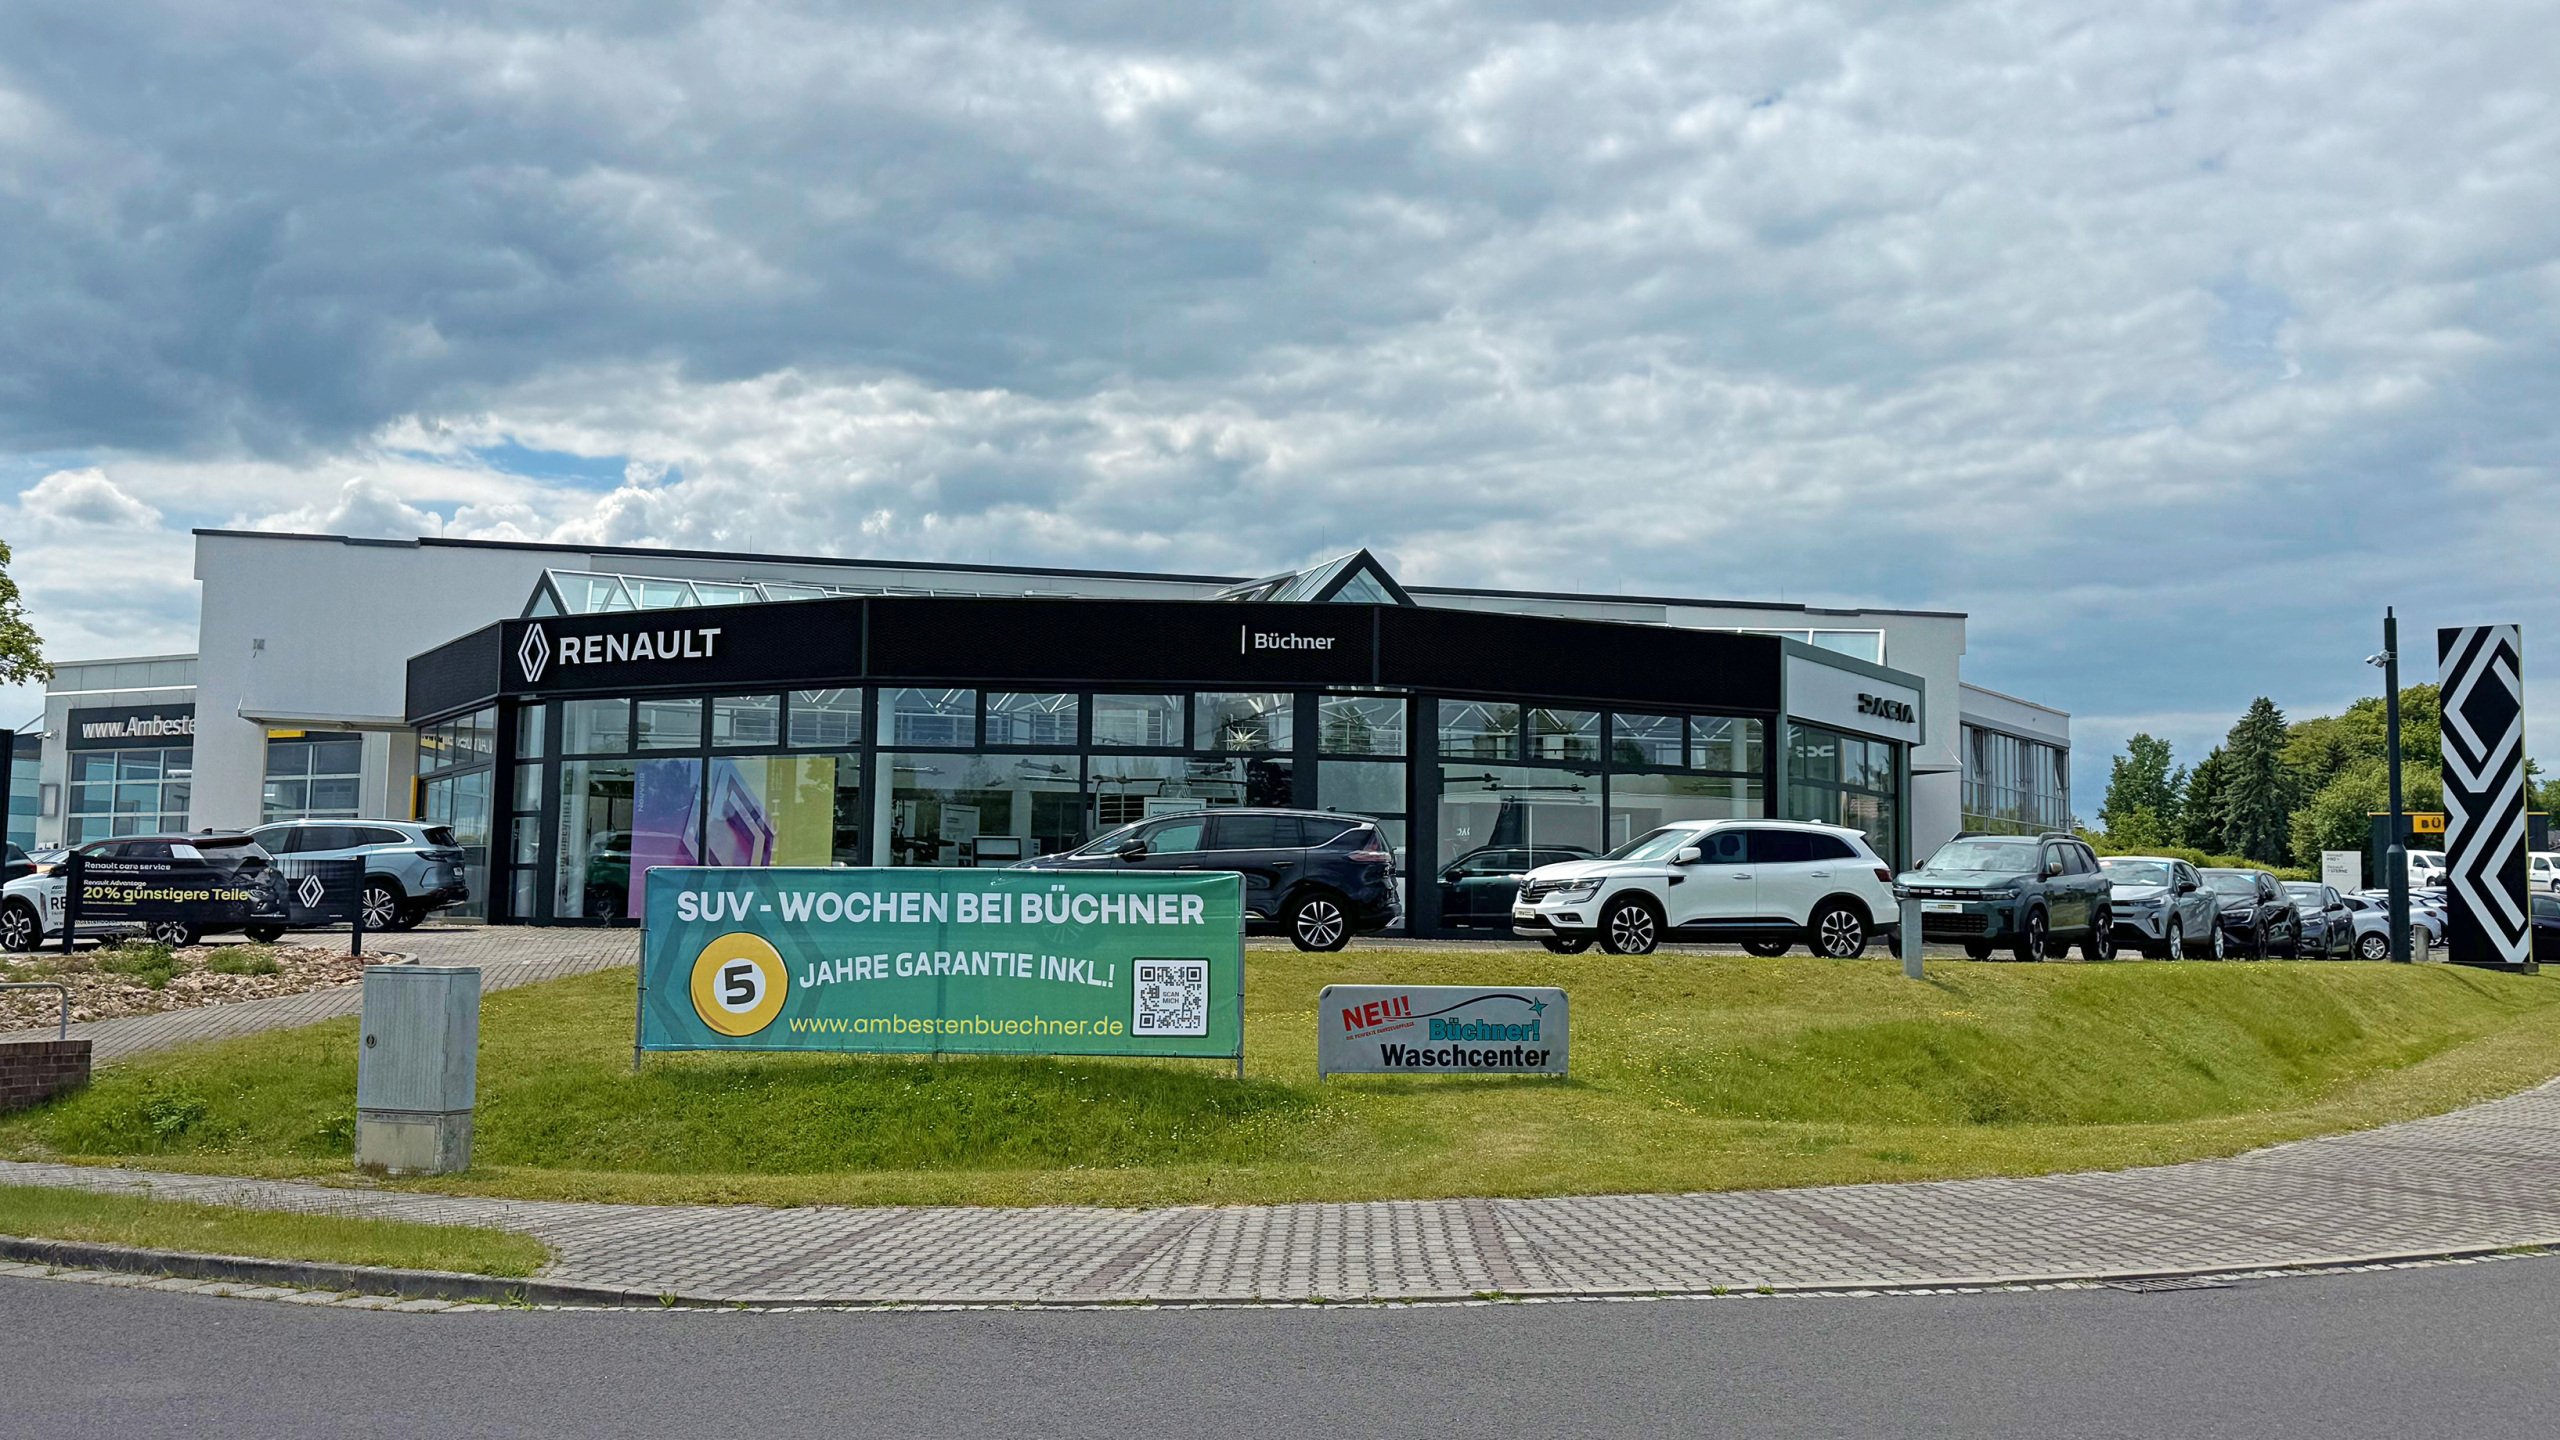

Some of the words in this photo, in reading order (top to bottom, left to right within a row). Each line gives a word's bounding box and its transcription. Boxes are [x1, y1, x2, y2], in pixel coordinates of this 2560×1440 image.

[559, 628, 722, 665] RENAULT
[1254, 632, 1336, 650] Büchner
[1858, 693, 1916, 723] DACIA
[84, 861, 117, 870] Renault
[139, 863, 171, 871] service
[83, 886, 120, 899] 20%
[123, 885, 210, 903] günstigere
[211, 887, 249, 901] Teile
[110, 879, 147, 888] Advantage
[677, 890, 754, 922] SUV
[778, 891, 949, 923] WOCHEN
[956, 892, 1012, 924] BEI
[1021, 884, 1205, 925] BÜCHNER
[724, 964, 756, 1005] 5
[799, 954, 889, 988] JAHRE
[896, 951, 1033, 978] GARANTIE
[1039, 955, 1116, 988] INKL.!
[789, 1014, 1124, 1036] www.ambestenbuechner.de
[1341, 995, 1412, 1032] NEU!
[1429, 1018, 1541, 1042] Büchner!
[1380, 1044, 1551, 1067] Waschcenter
